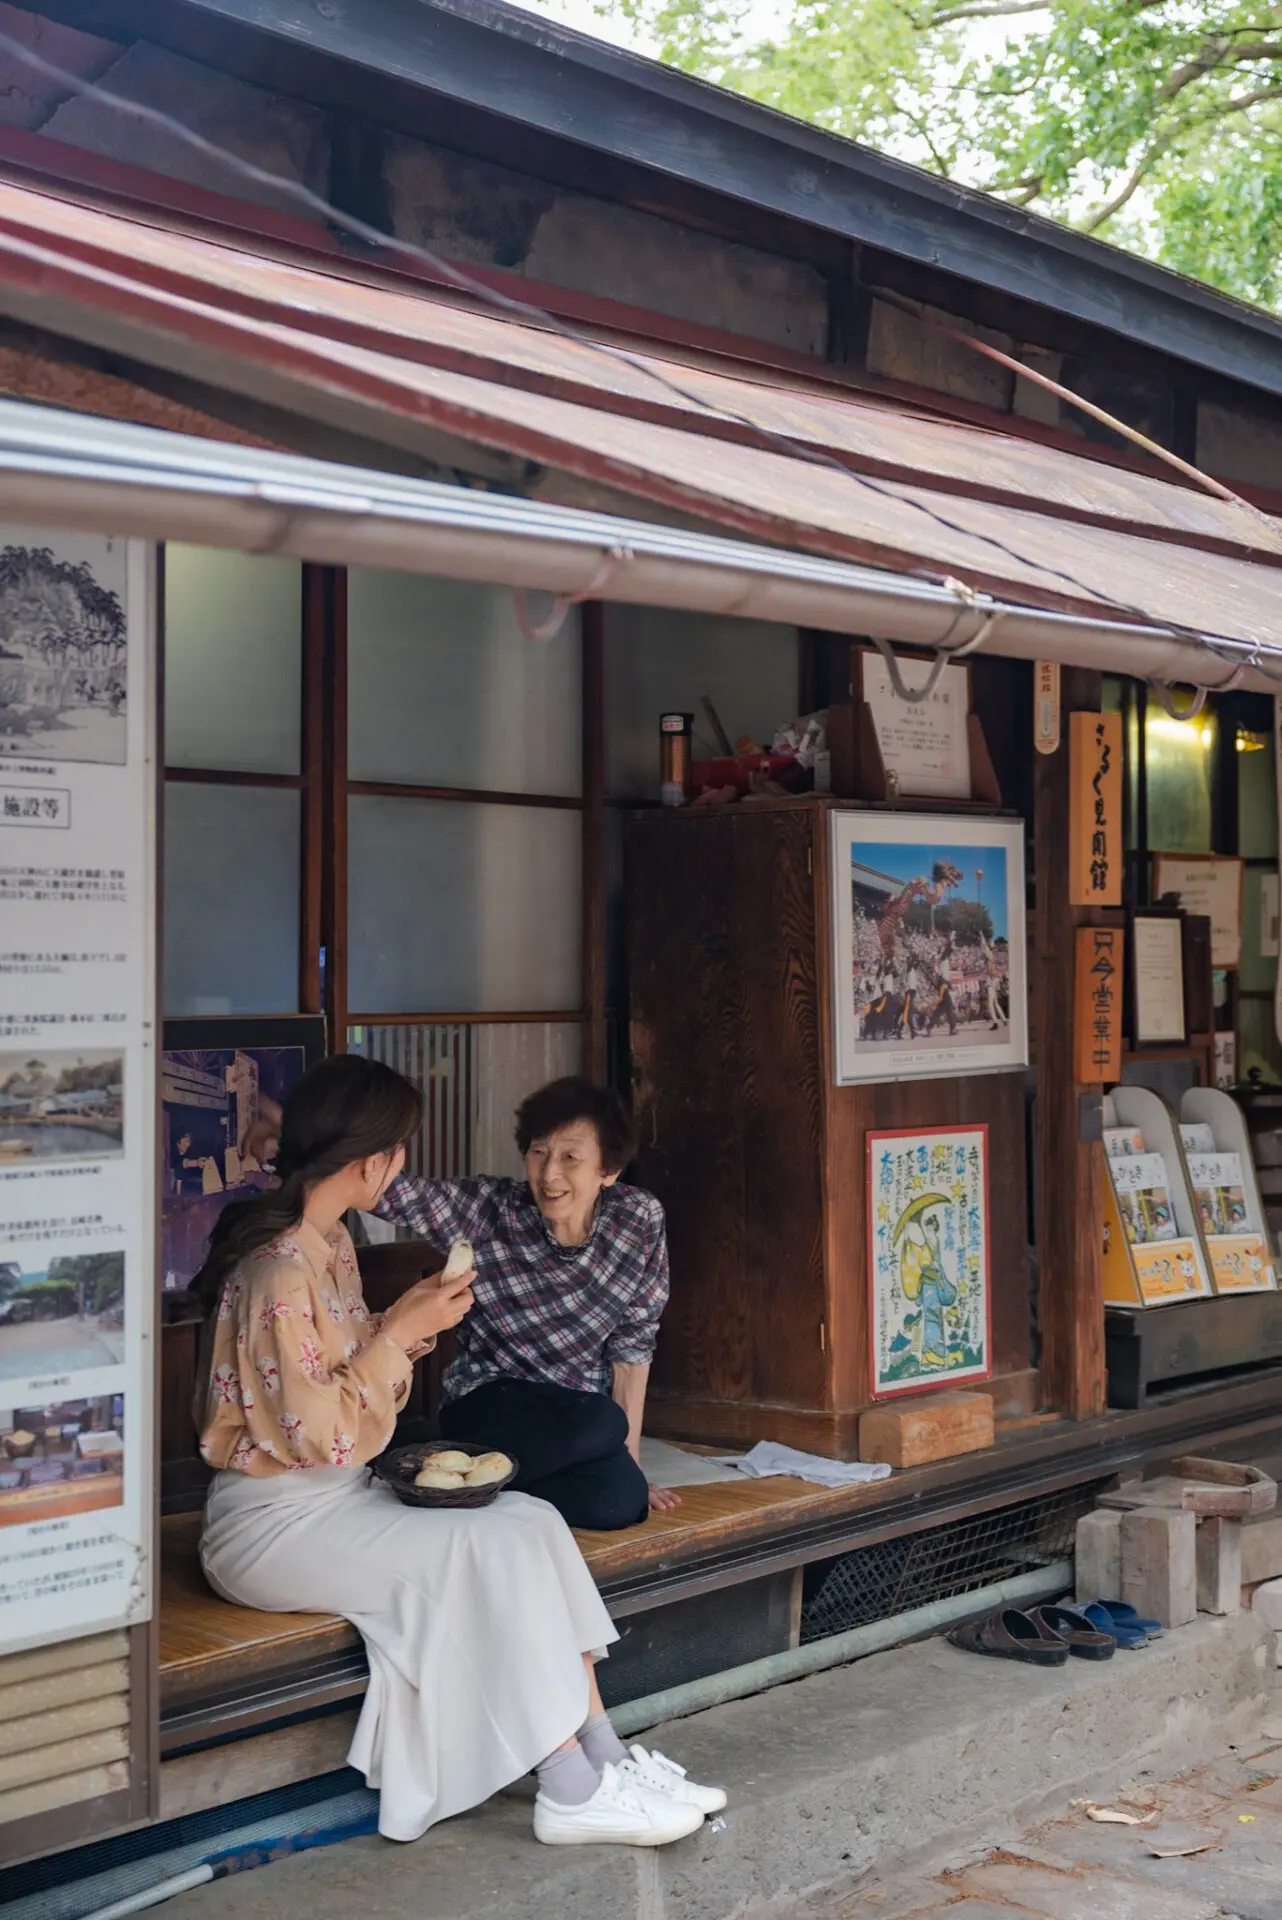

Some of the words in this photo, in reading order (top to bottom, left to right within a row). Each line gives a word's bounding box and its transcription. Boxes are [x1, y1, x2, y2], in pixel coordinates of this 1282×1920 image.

[1090, 931, 1115, 1076] 只今営業中
